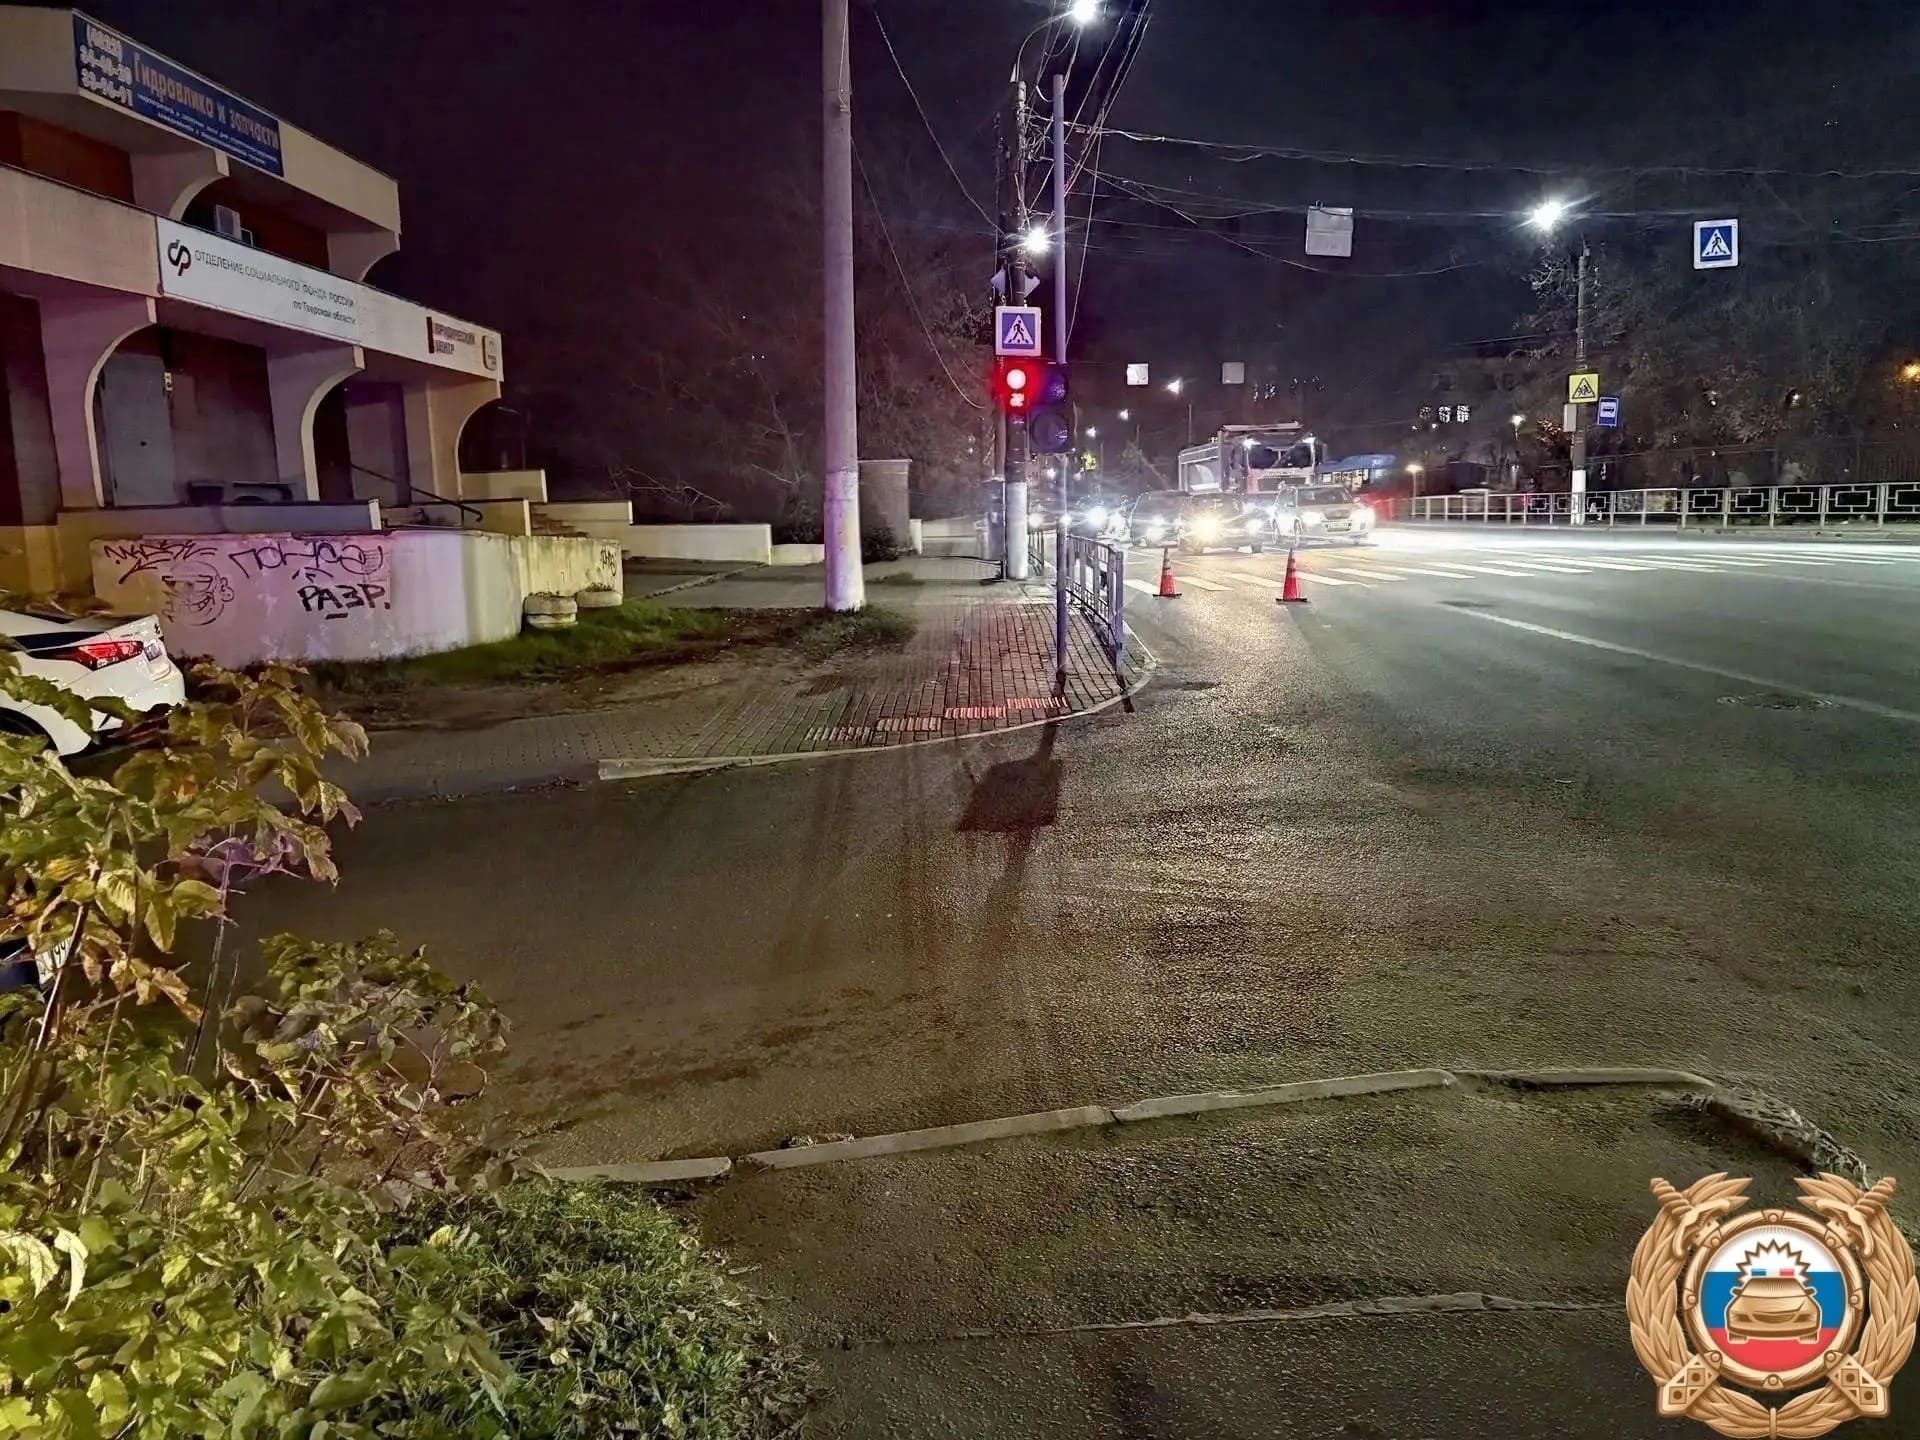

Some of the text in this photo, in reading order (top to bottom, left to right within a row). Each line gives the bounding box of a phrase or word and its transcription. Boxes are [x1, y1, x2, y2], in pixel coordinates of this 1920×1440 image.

[134, 52, 214, 118] Гидравлика
[217, 101, 226, 124] и
[230, 110, 280, 150] запчасти
[194, 249, 354, 307] ОТДЕЛЕНИЕ СОЦИАЛЬНОГО ФОНДА РОССИИ
[303, 301, 331, 318] Тверской
[333, 311, 356, 324] области
